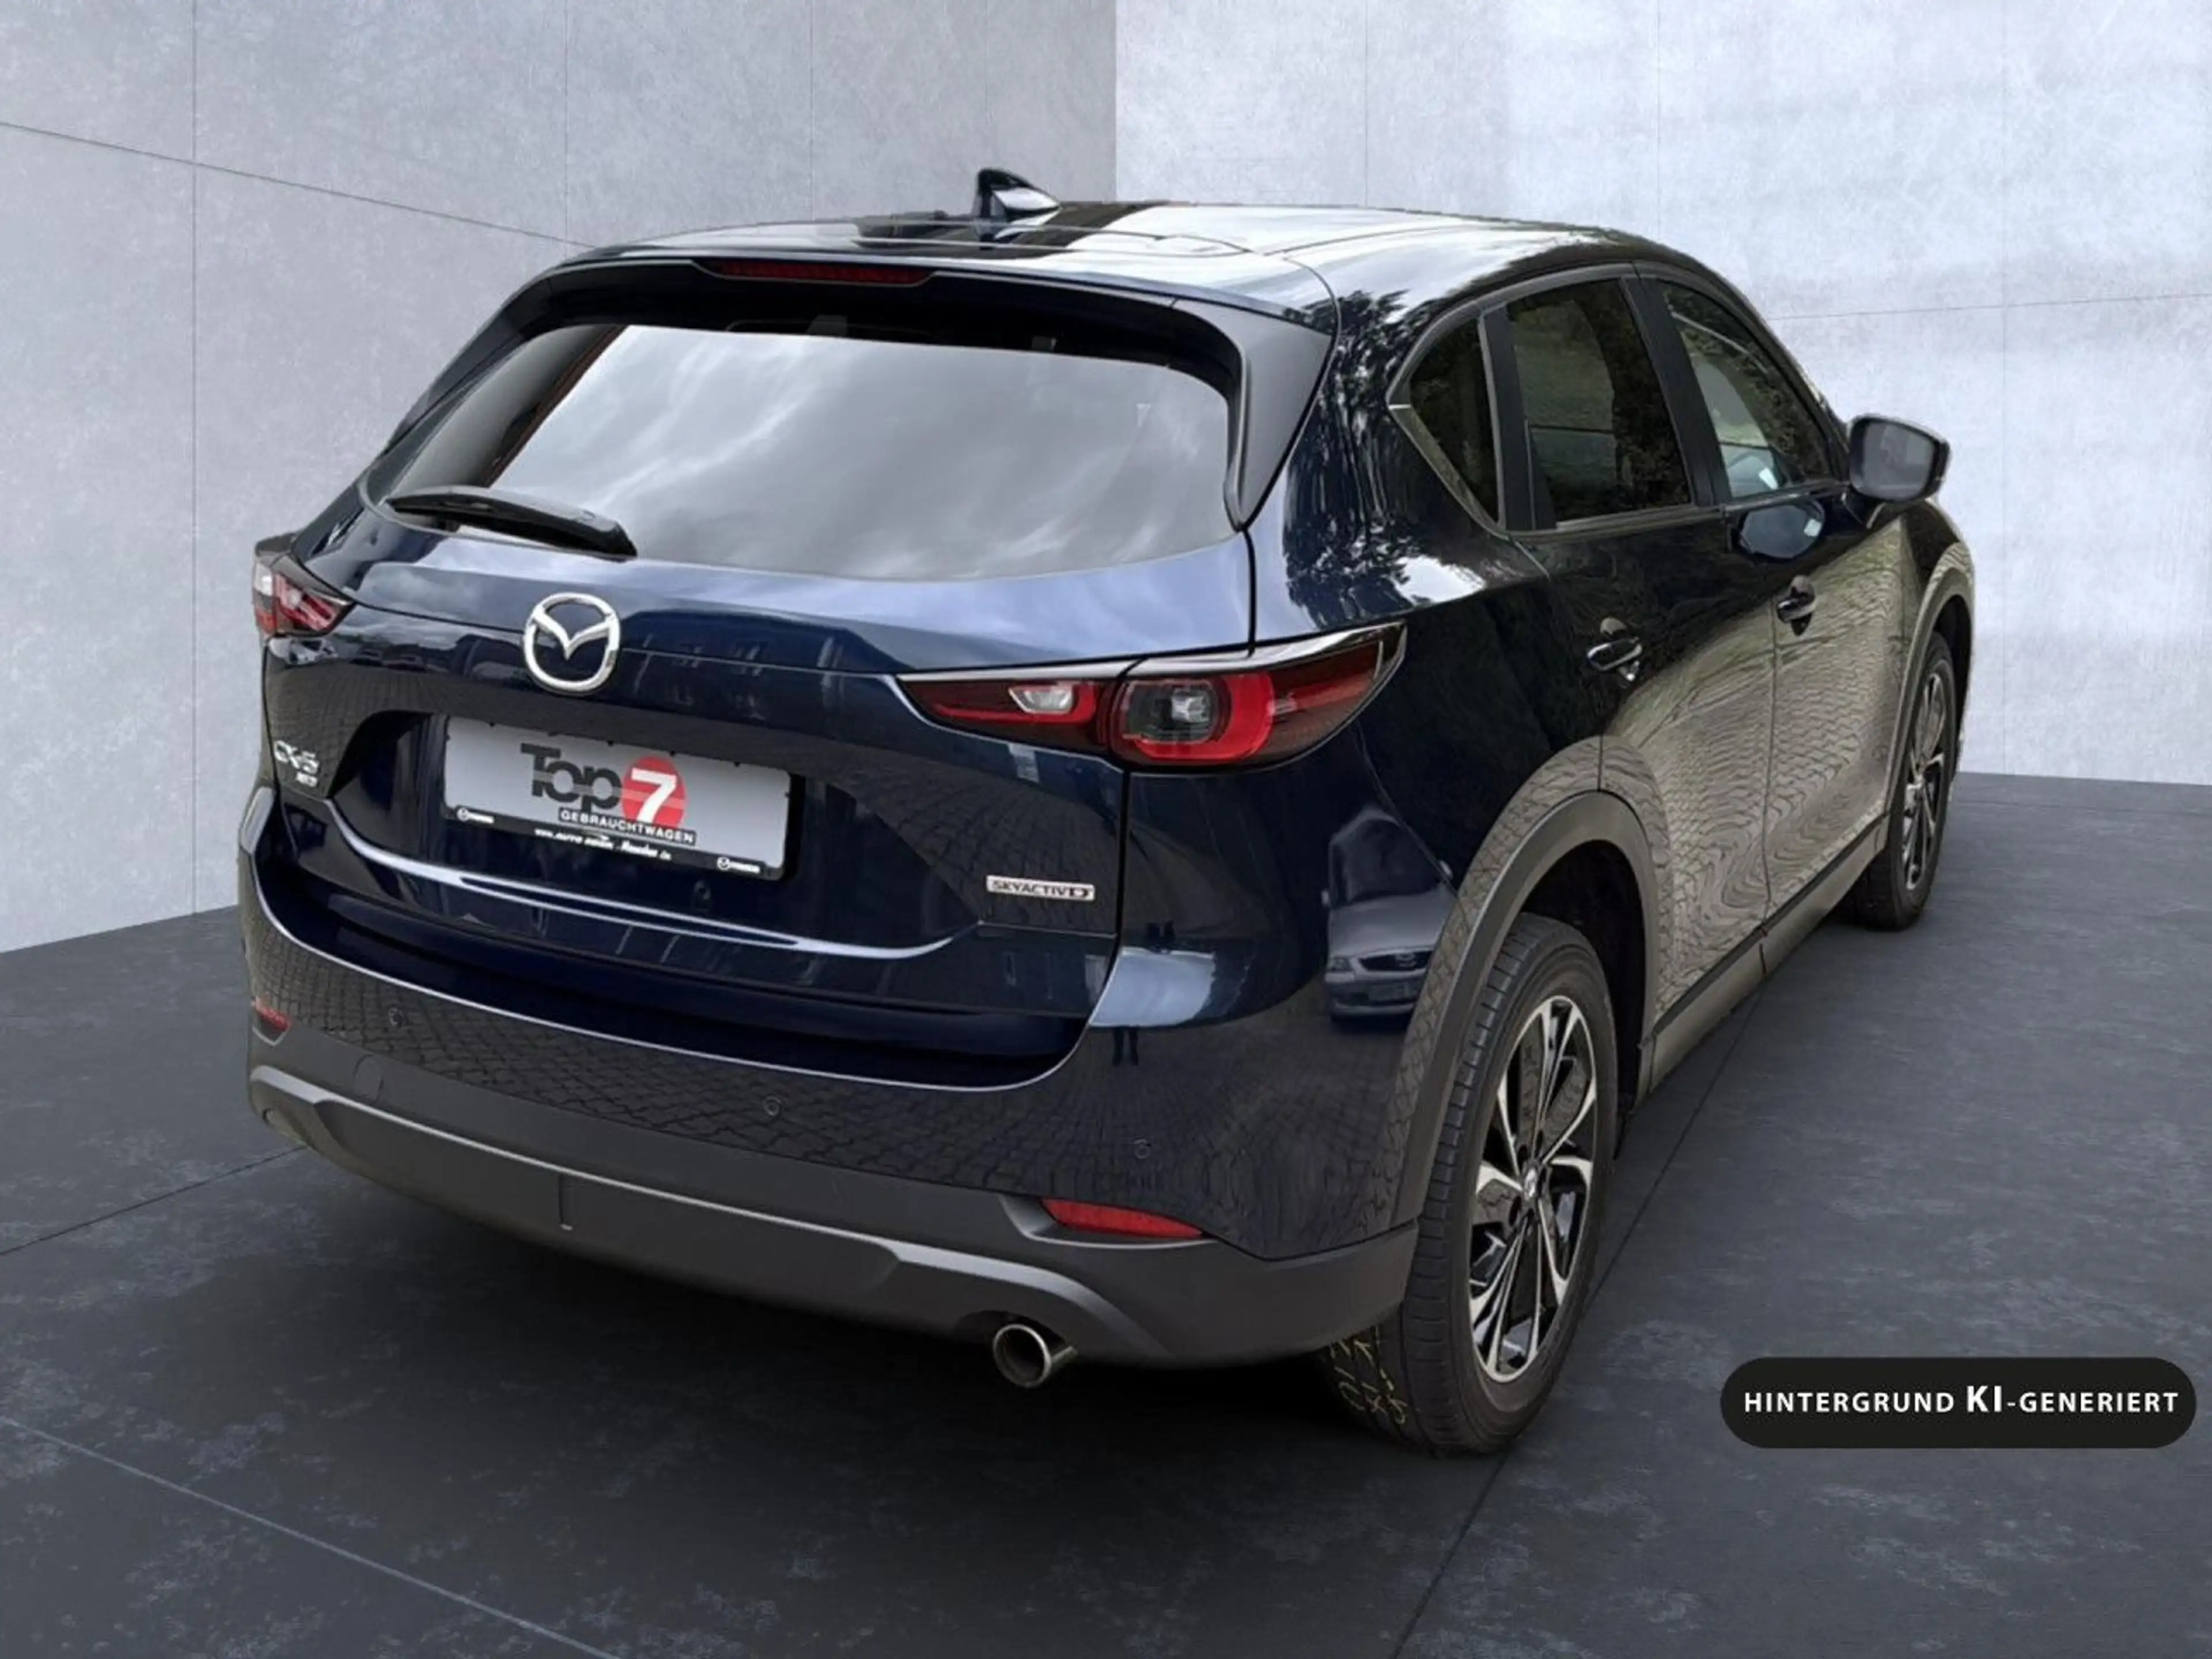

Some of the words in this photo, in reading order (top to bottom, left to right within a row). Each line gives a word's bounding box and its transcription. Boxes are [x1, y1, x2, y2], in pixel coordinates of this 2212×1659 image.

[521, 743, 622, 813] Top
[631, 767, 677, 824] 7
[560, 809, 694, 842] GEBRAUCHTWAGEN
